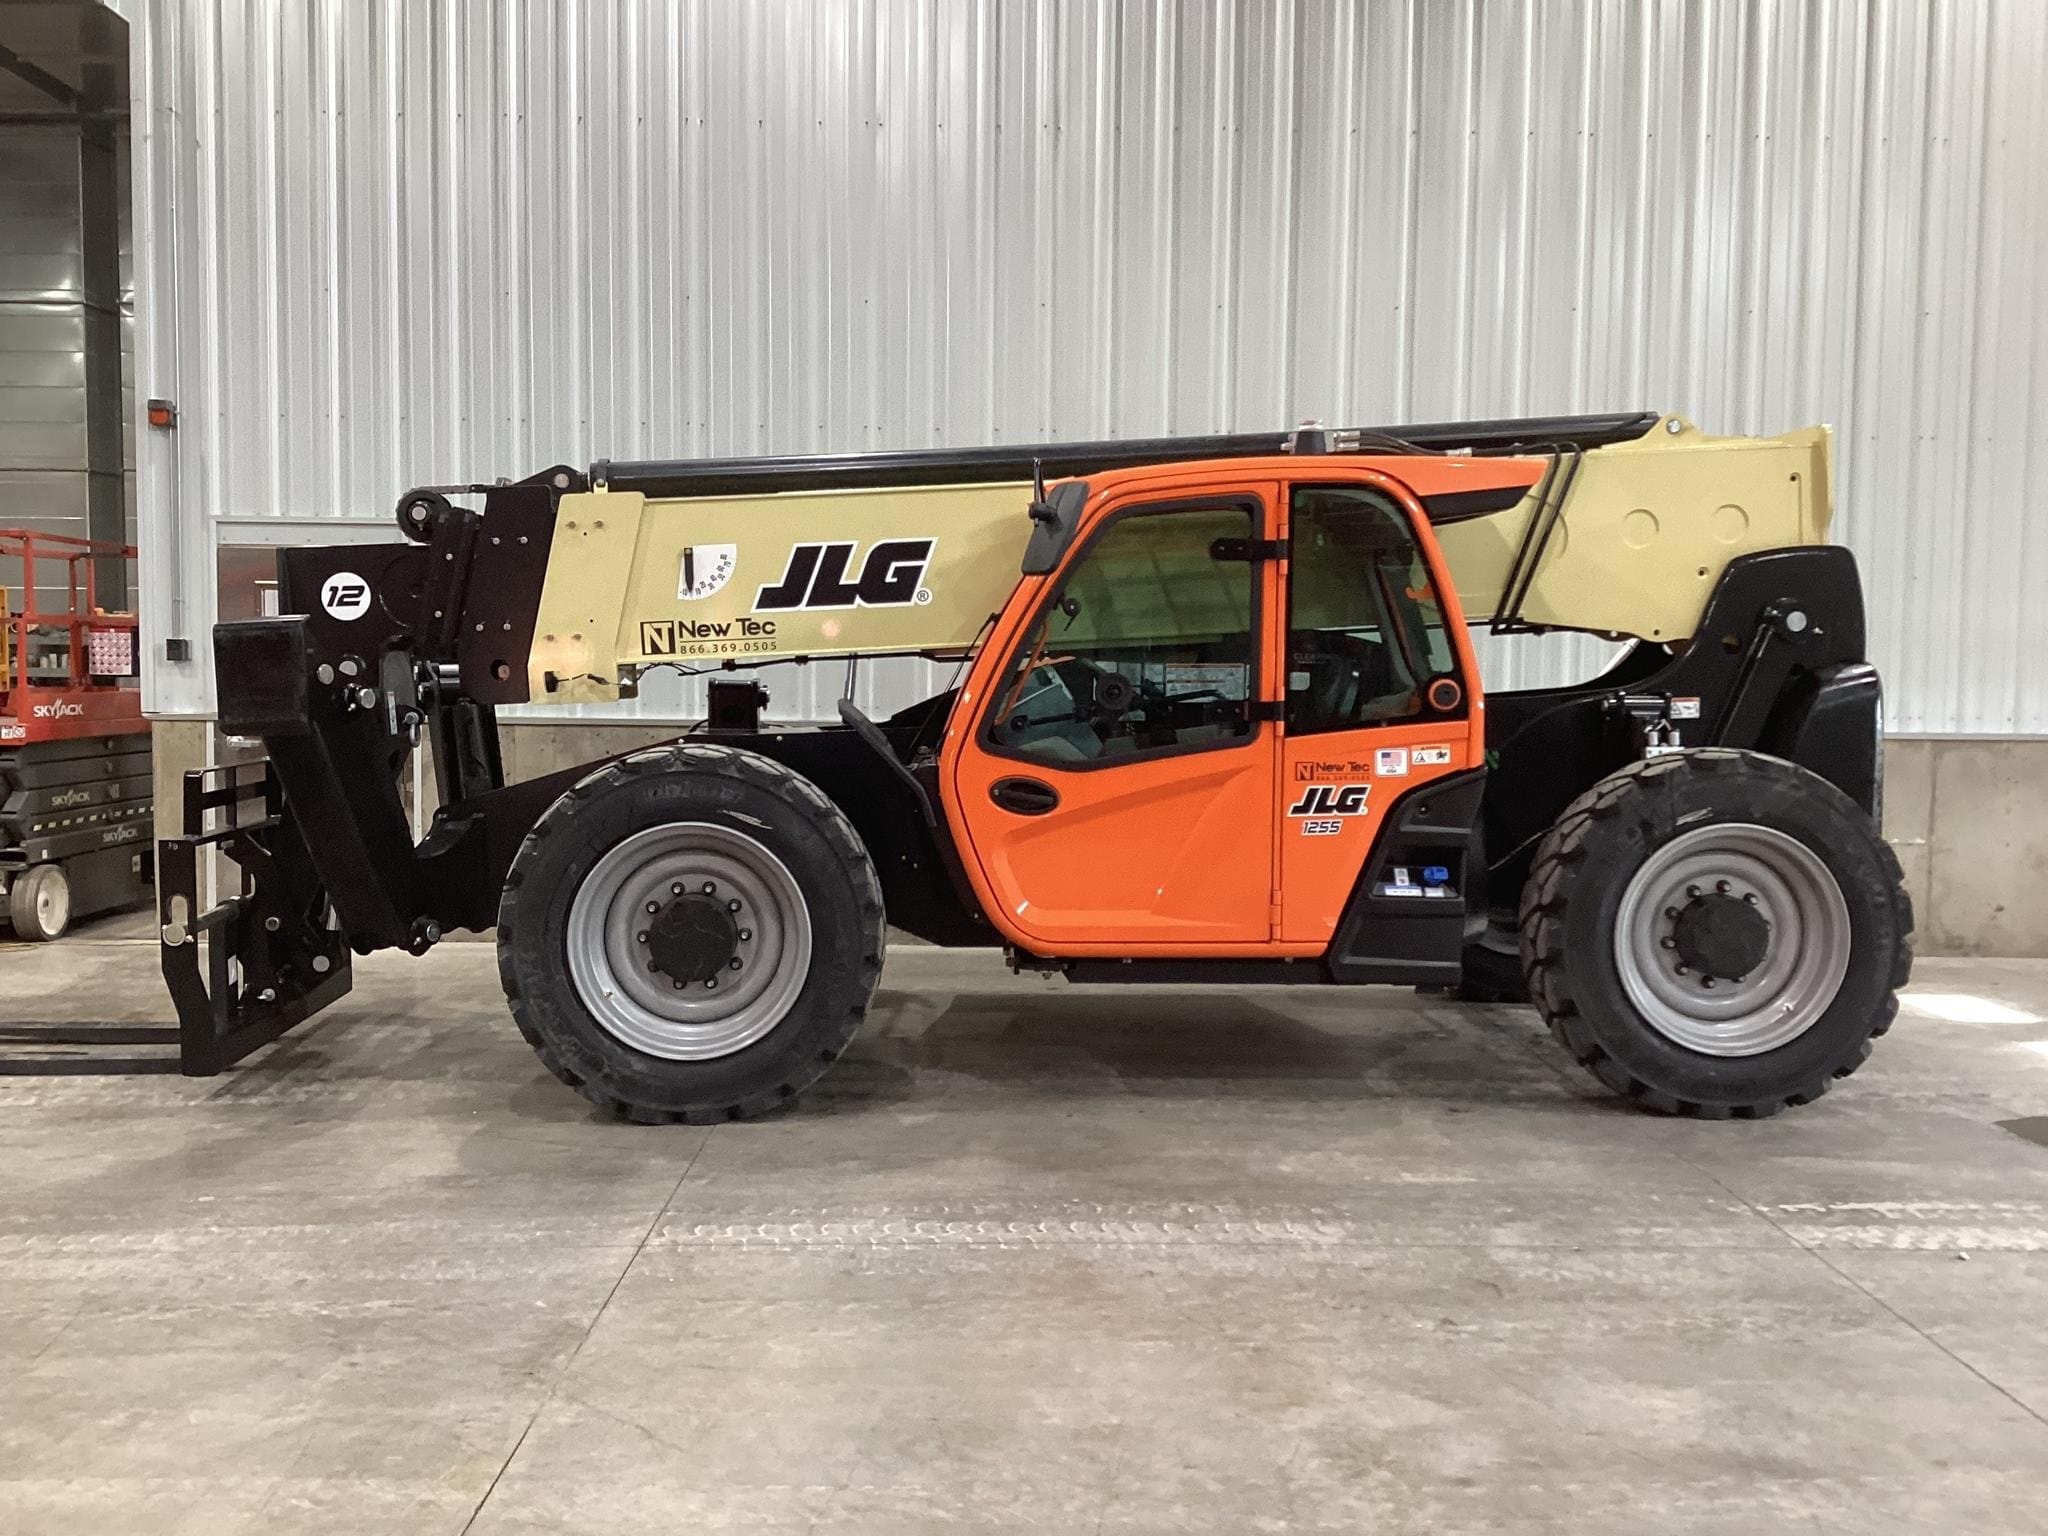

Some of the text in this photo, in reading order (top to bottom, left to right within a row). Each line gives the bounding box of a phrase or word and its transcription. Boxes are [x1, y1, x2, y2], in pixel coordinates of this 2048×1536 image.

[752, 538, 936, 611] JLG
[327, 585, 365, 607] 12
[678, 617, 776, 638] New Tec
[680, 641, 777, 654] 866.369.0505
[33, 698, 84, 719] SKYJACK
[1316, 762, 1345, 772] New
[1347, 761, 1370, 772] Tec
[51, 789, 90, 806] SKYJACK
[1288, 785, 1370, 816] JLG
[103, 825, 138, 842] SKYJACK
[1303, 821, 1342, 835] 1255
